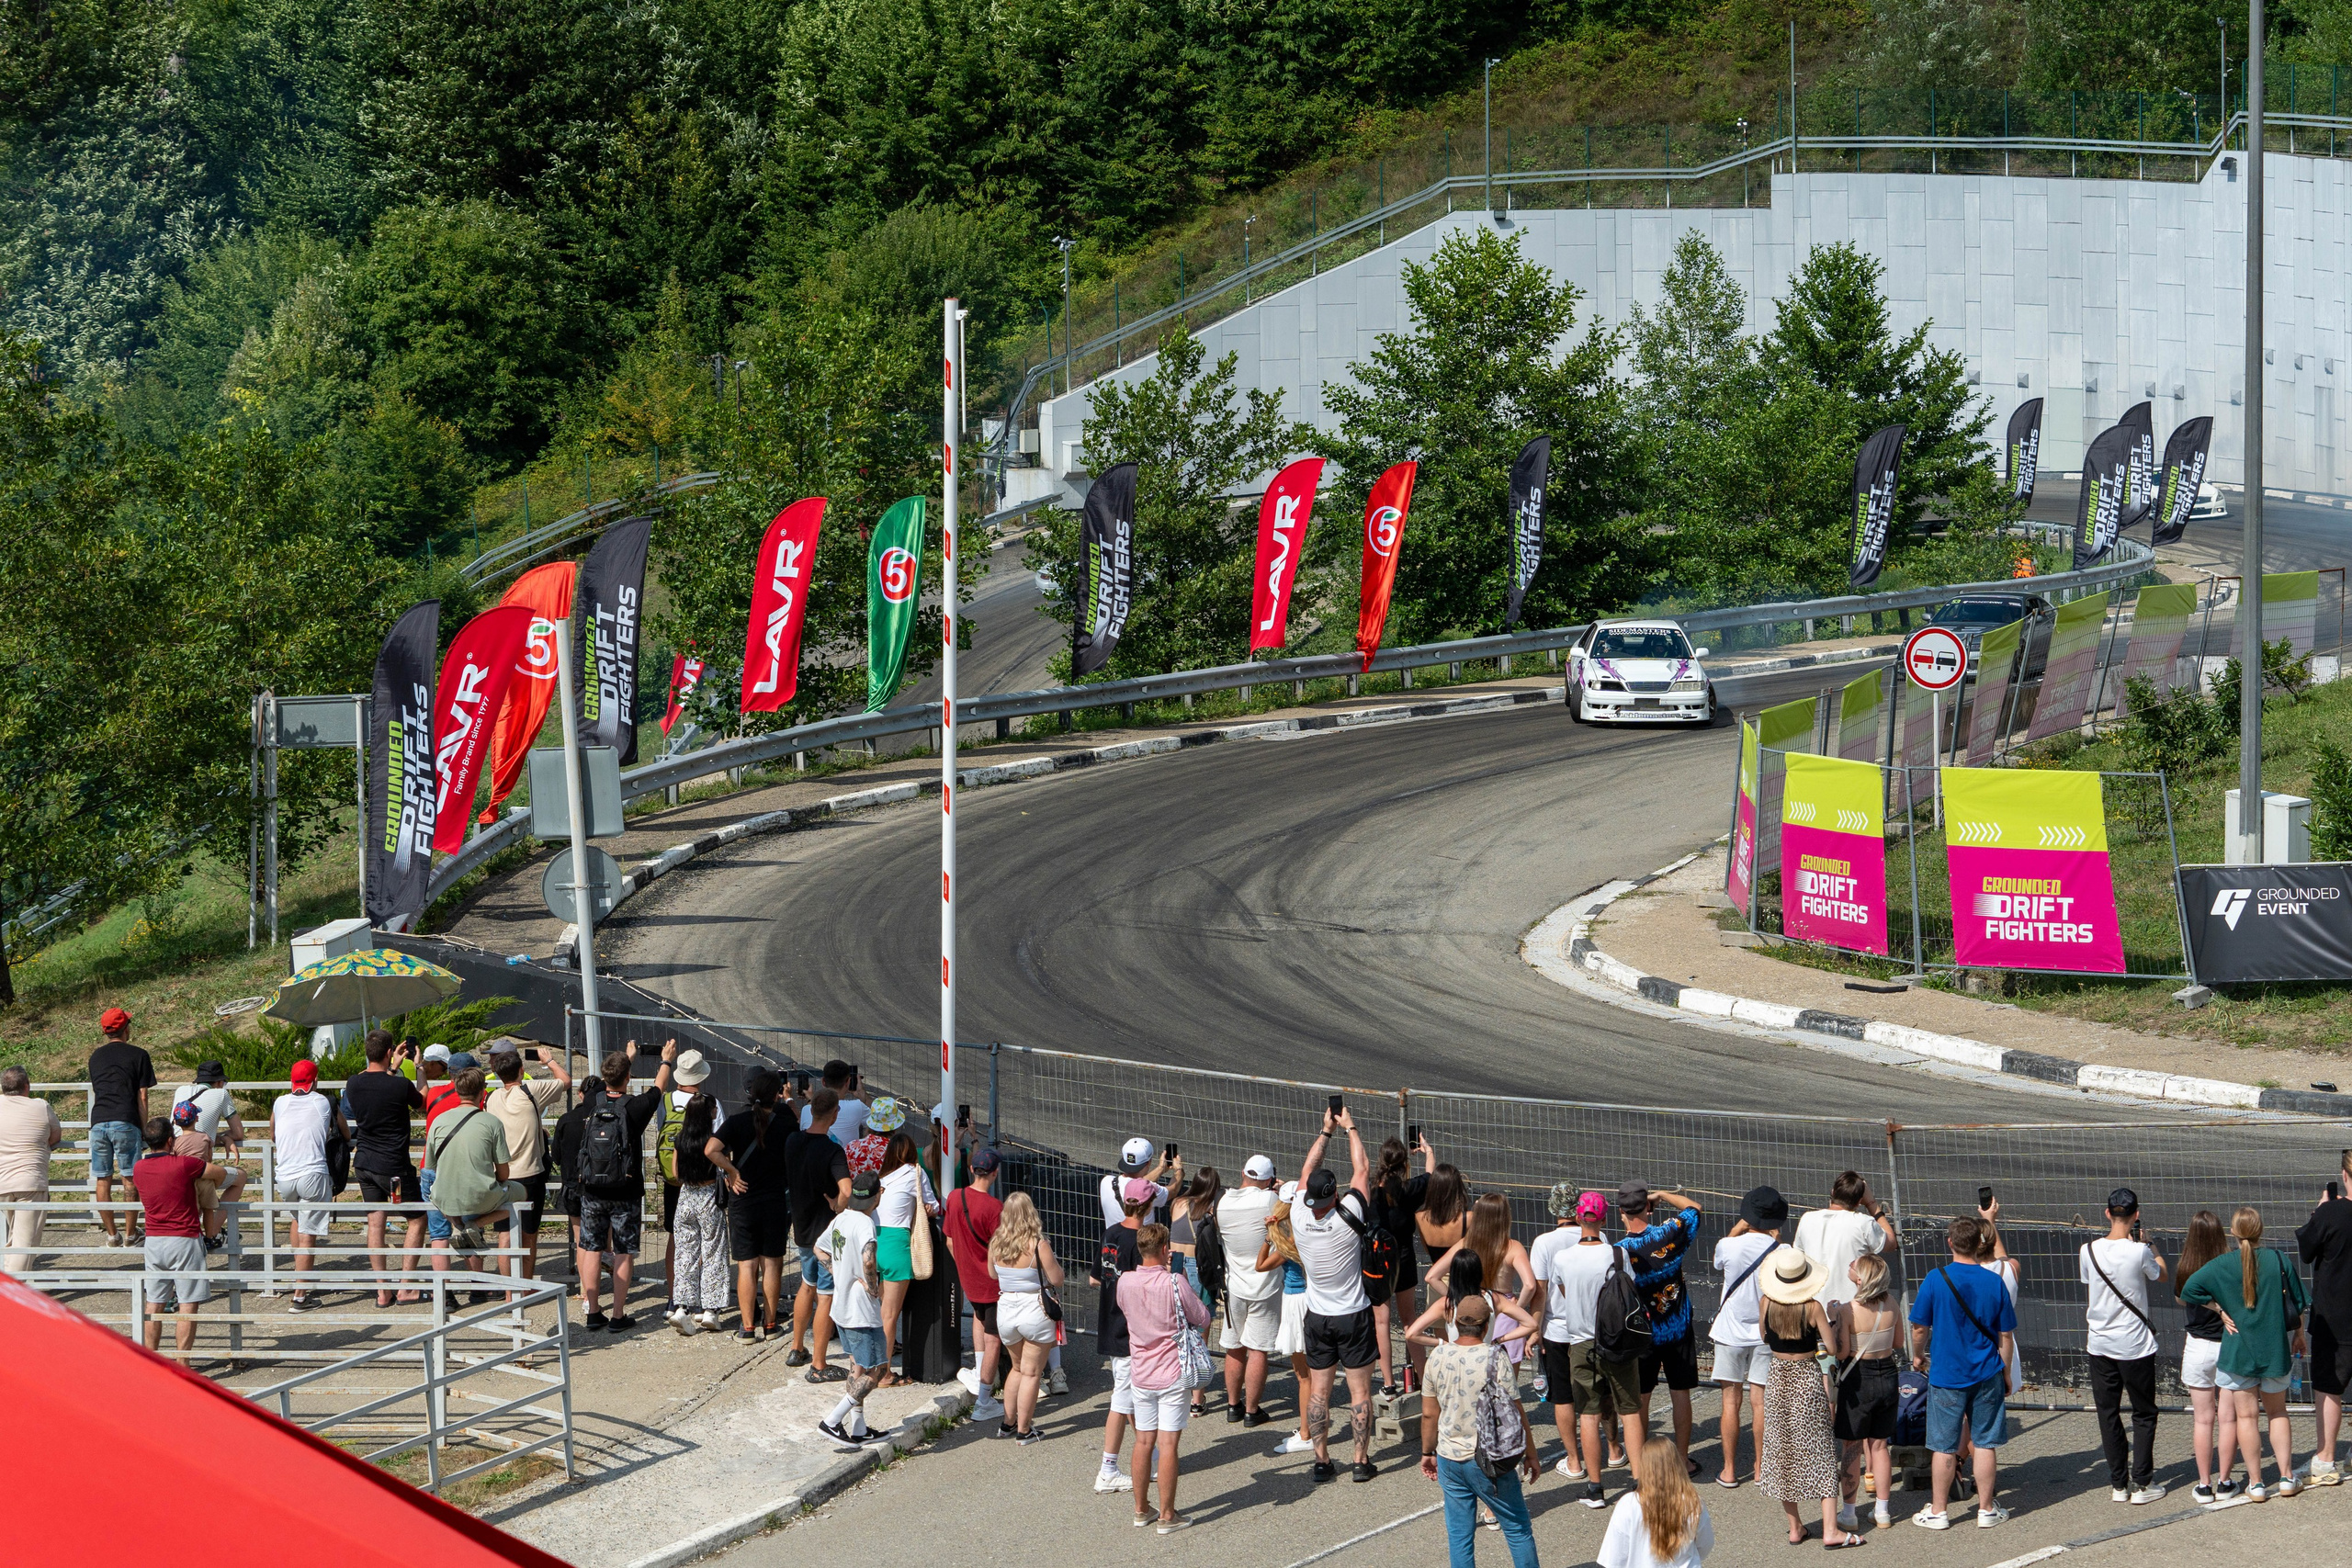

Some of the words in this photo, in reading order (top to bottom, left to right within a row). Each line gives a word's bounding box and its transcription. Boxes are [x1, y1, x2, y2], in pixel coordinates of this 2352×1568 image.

[2023, 428, 2039, 493] FIGHTERS
[2130, 445, 2142, 511] DRIFT
[2142, 434, 2152, 504] FIGHTERS
[2176, 451, 2205, 525] FIGHTERS
[1868, 470, 1894, 563] FIGHTERS
[2084, 479, 2099, 546] GROUNDED
[2090, 473, 2114, 552] DRIFT
[2102, 463, 2125, 548] FIGHTERS
[1085, 542, 1101, 635] GROUNDED
[1091, 533, 1114, 646] DRIFT
[1108, 518, 1130, 639] FIGHTERS
[583, 615, 599, 721] GROUNDED
[616, 584, 637, 726] FIGHTERS
[1609, 627, 1671, 636] SIDEMASTERS
[595, 603, 619, 738] DRIFT
[413, 682, 438, 857] FIGHTERS
[454, 765, 469, 795] Family
[462, 741, 476, 765] Brand
[471, 717, 483, 742] since
[478, 695, 490, 716] 1997
[384, 720, 403, 853] GROUNDED
[394, 705, 420, 870] DRIFT
[1796, 869, 1858, 900] DRIFT
[1801, 854, 1850, 876] GROUNDED
[1983, 876, 2062, 896] GROUNDED
[2256, 887, 2341, 900] GROUNDED
[1802, 895, 1869, 924] FIGHTERS
[1974, 893, 2075, 920] DRIFT
[1985, 919, 2094, 943] FIGHTERS
[2257, 902, 2309, 915] EVENT
